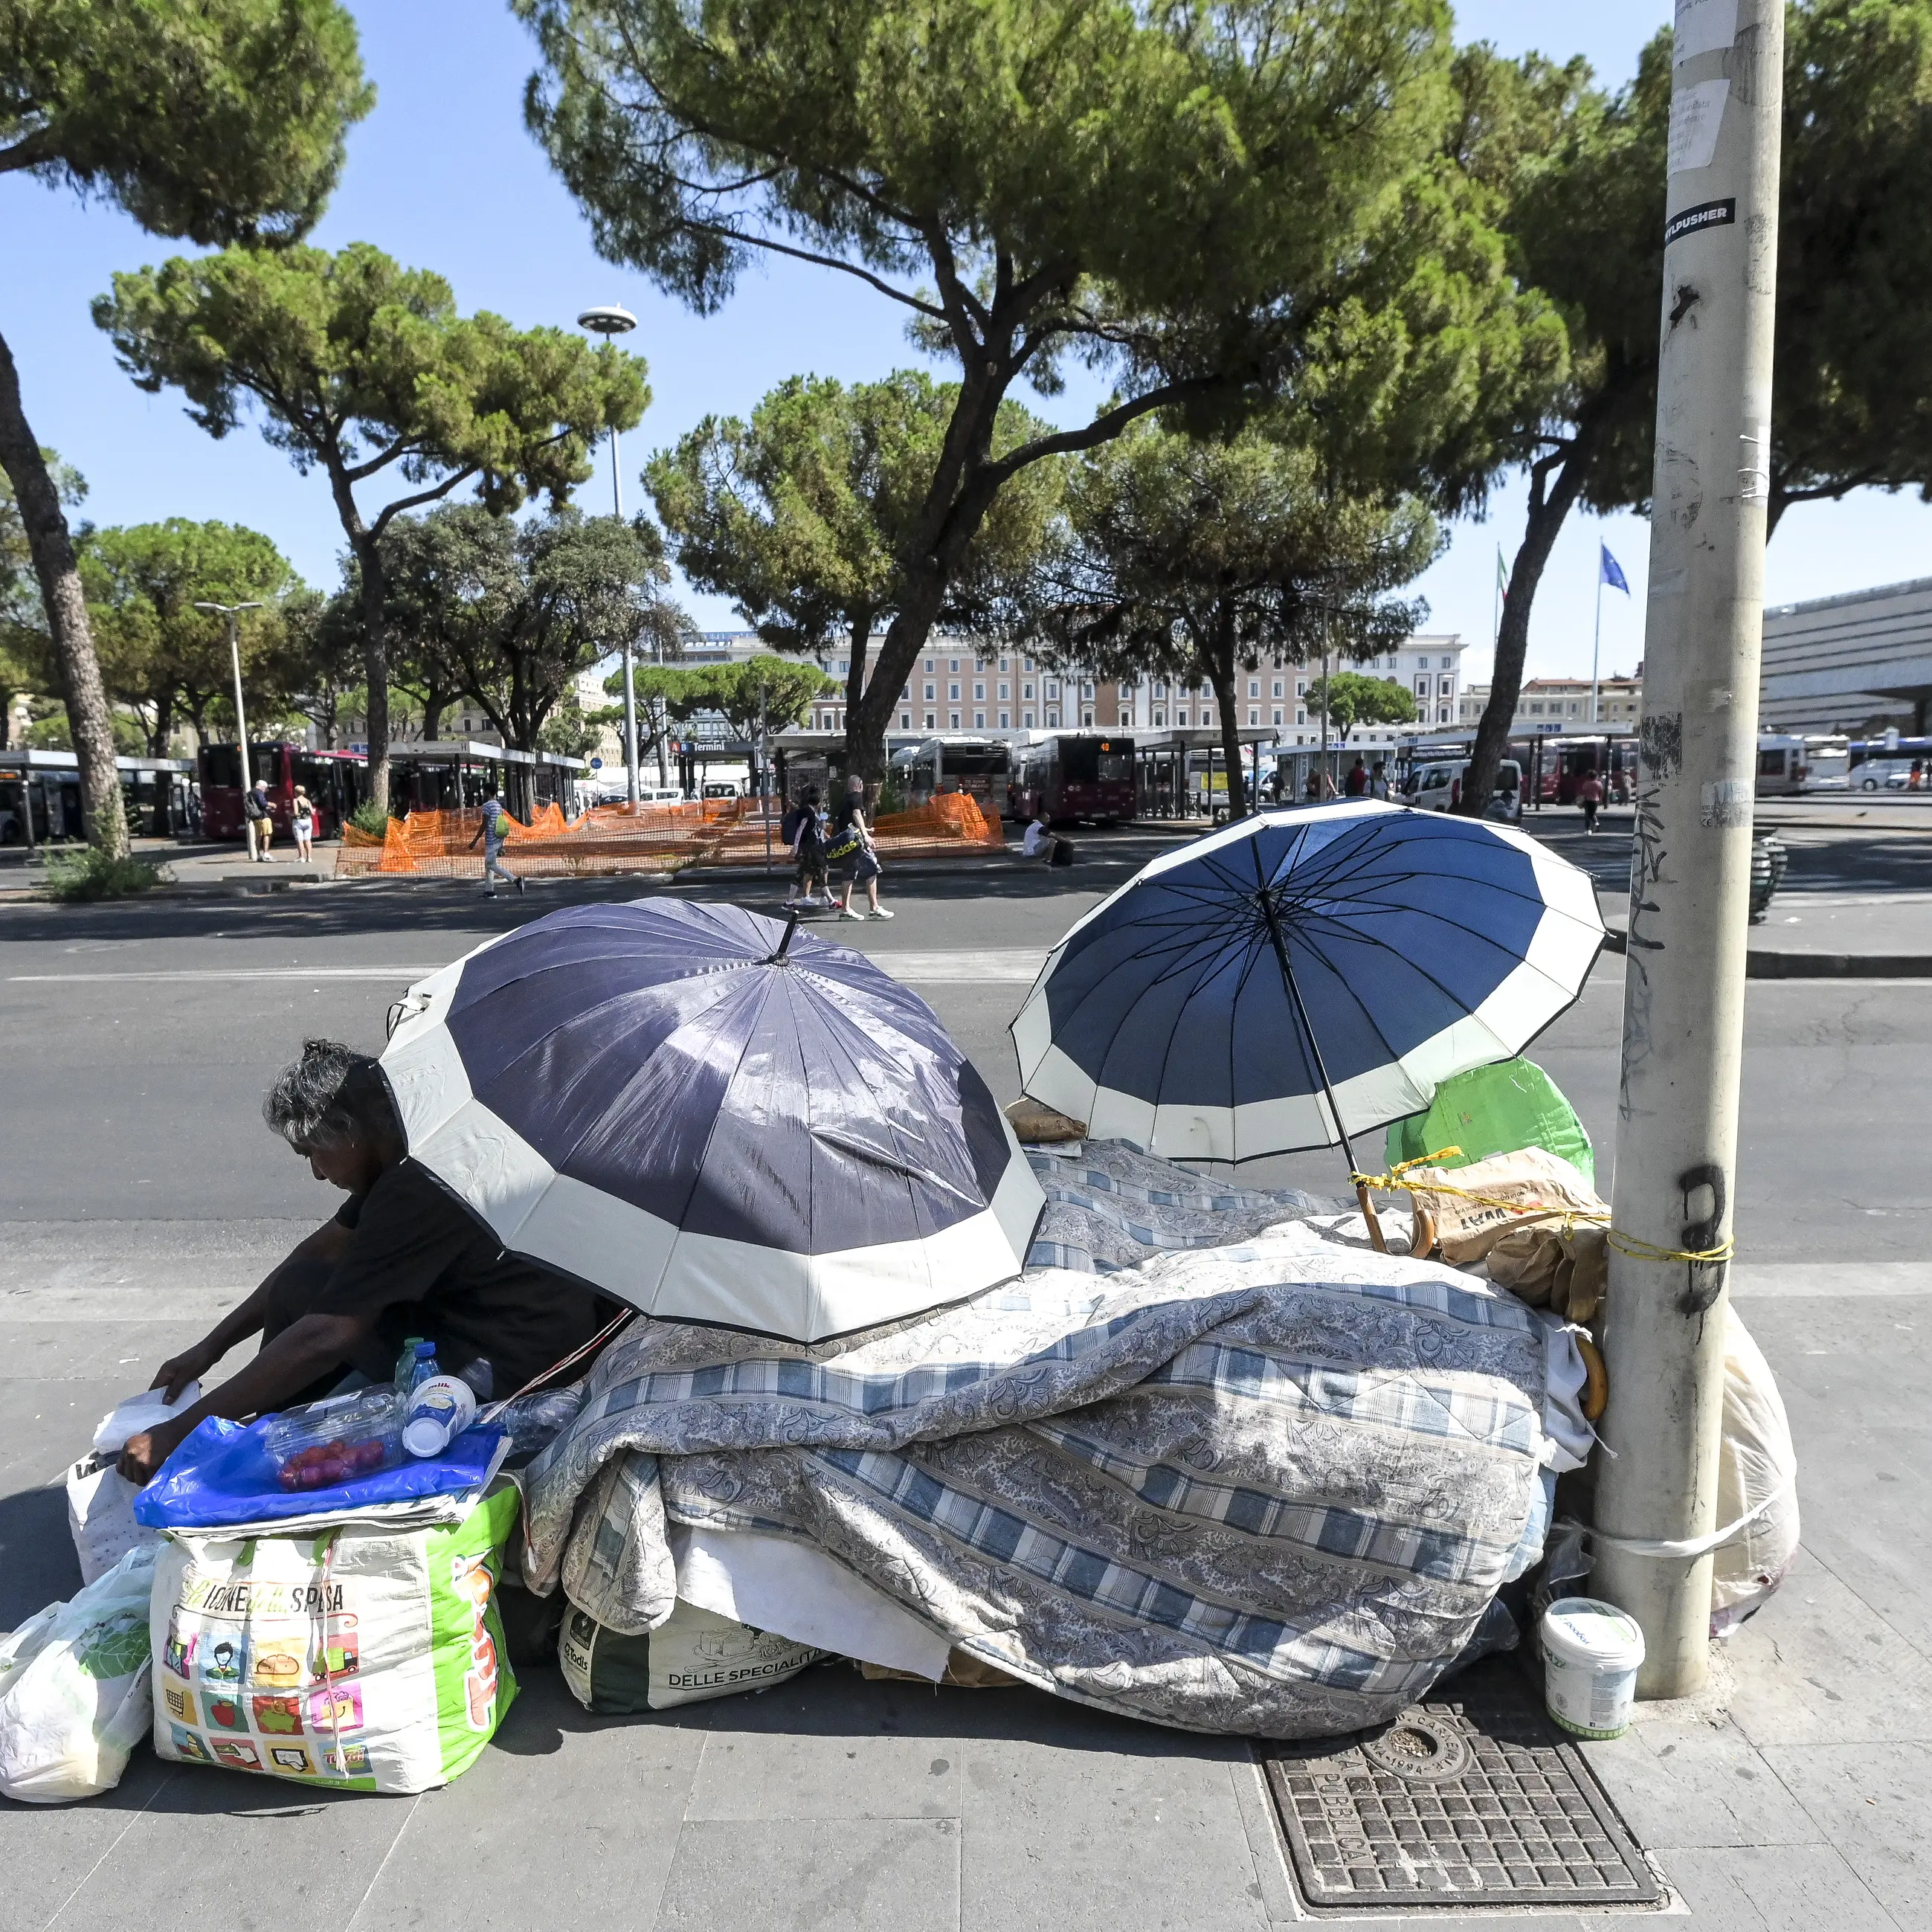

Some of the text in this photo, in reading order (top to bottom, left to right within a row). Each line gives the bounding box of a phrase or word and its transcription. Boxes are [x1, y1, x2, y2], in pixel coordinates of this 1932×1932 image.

[693, 742, 725, 752] Termini
[1101, 743, 1110, 751] 40
[202, 1584, 248, 1612] ICONE
[669, 1672, 725, 1687] DELLE
[1314, 1773, 1370, 1864] PUBBLICA
